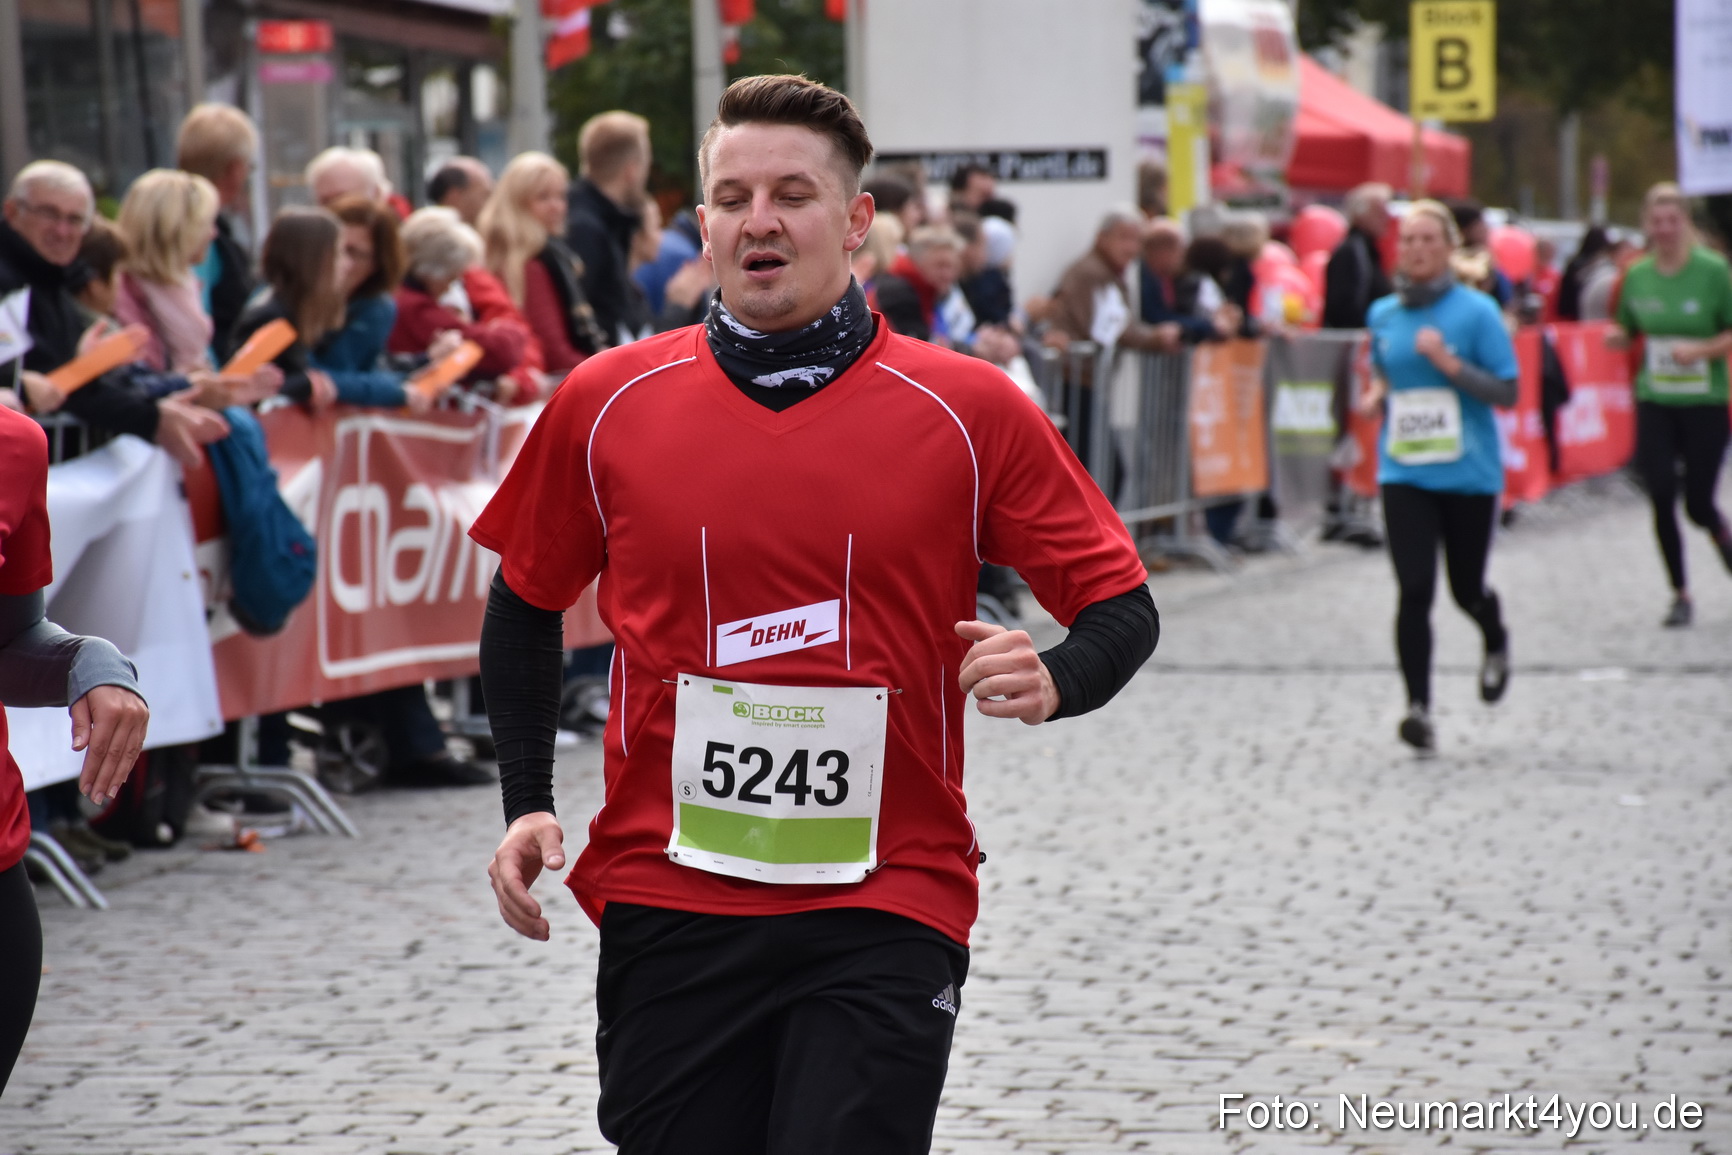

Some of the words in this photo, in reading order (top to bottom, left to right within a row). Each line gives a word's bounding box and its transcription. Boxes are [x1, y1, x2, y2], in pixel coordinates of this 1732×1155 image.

[1434, 37, 1471, 91] B
[750, 619, 807, 647] DEHN
[752, 704, 825, 722] BOCK
[702, 740, 850, 806] 5243
[683, 785, 691, 796] S
